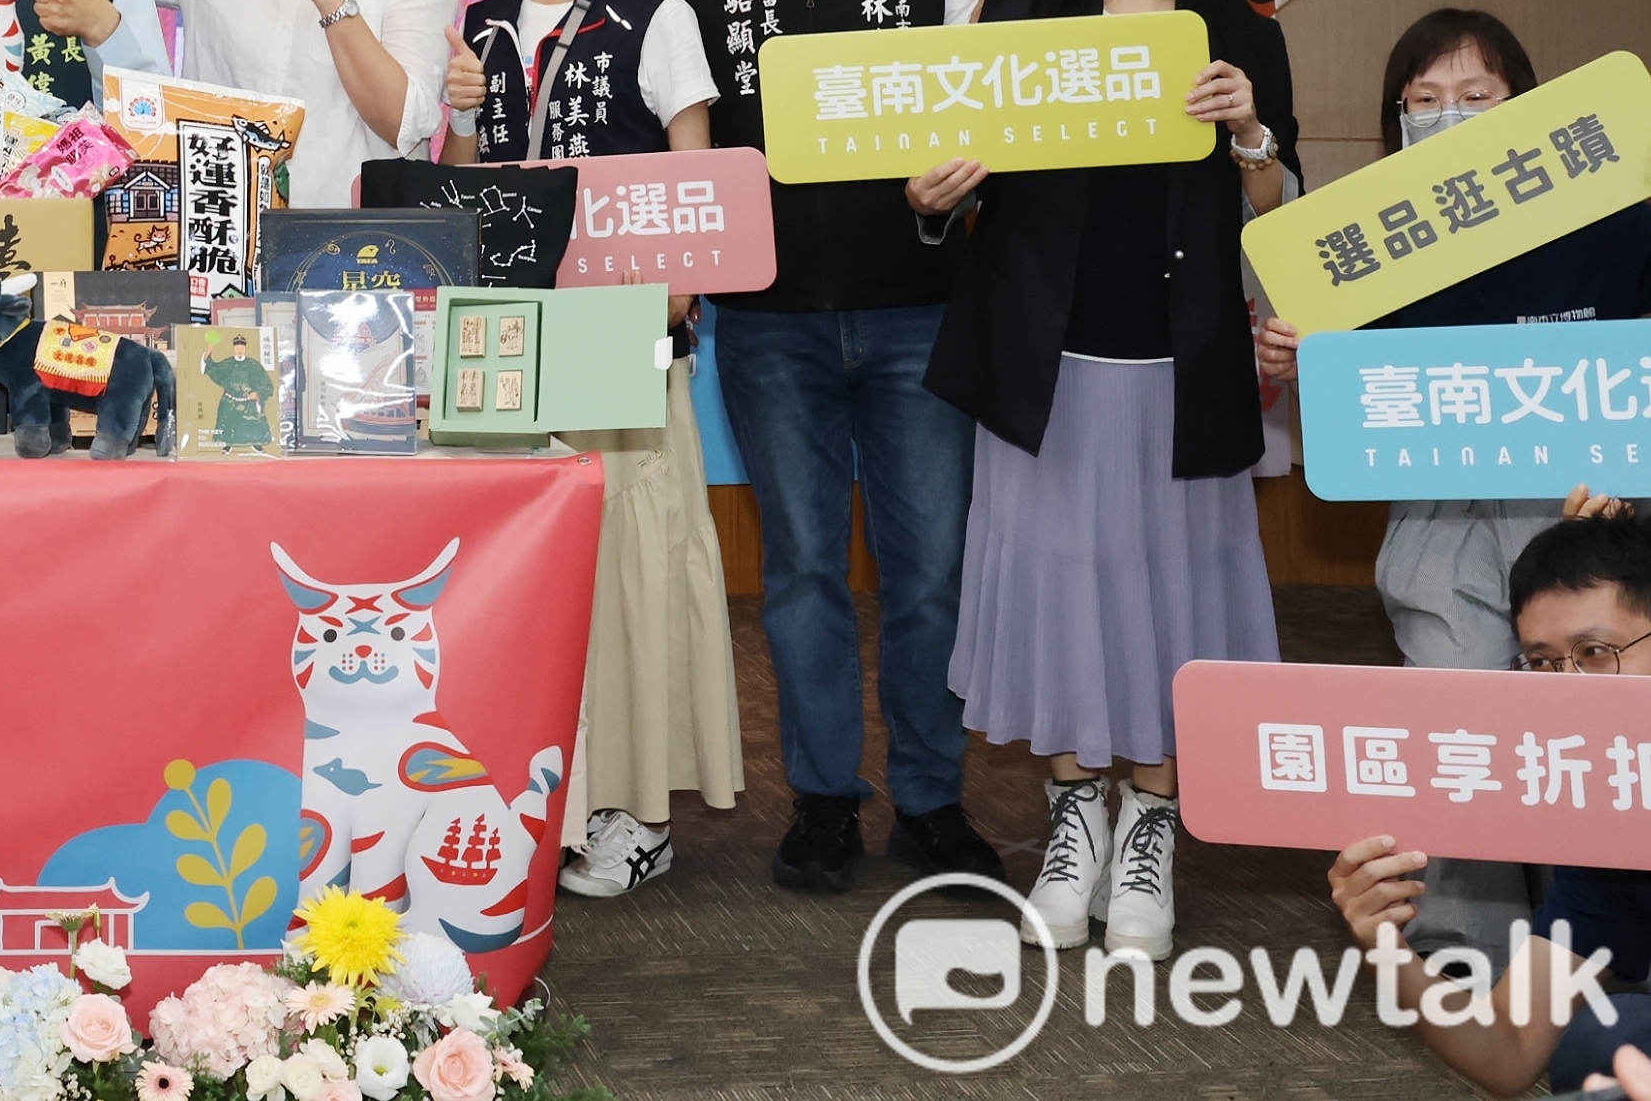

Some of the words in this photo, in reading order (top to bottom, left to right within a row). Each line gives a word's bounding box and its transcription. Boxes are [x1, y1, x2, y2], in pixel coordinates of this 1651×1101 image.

[489, 72, 510, 145] 副主任
[563, 62, 591, 159] 林美燕
[593, 51, 614, 126] 市議員
[812, 44, 1161, 121] 臺南文化選品
[817, 128, 972, 154] TAINAN
[1004, 118, 1159, 144] SELECT
[187, 132, 241, 277] 好運香酥脆
[1314, 112, 1622, 288] 選品逛古蹟
[577, 249, 722, 275] SELECT
[1359, 356, 1651, 430] 臺南文化
[1364, 443, 1550, 468] TAINAN
